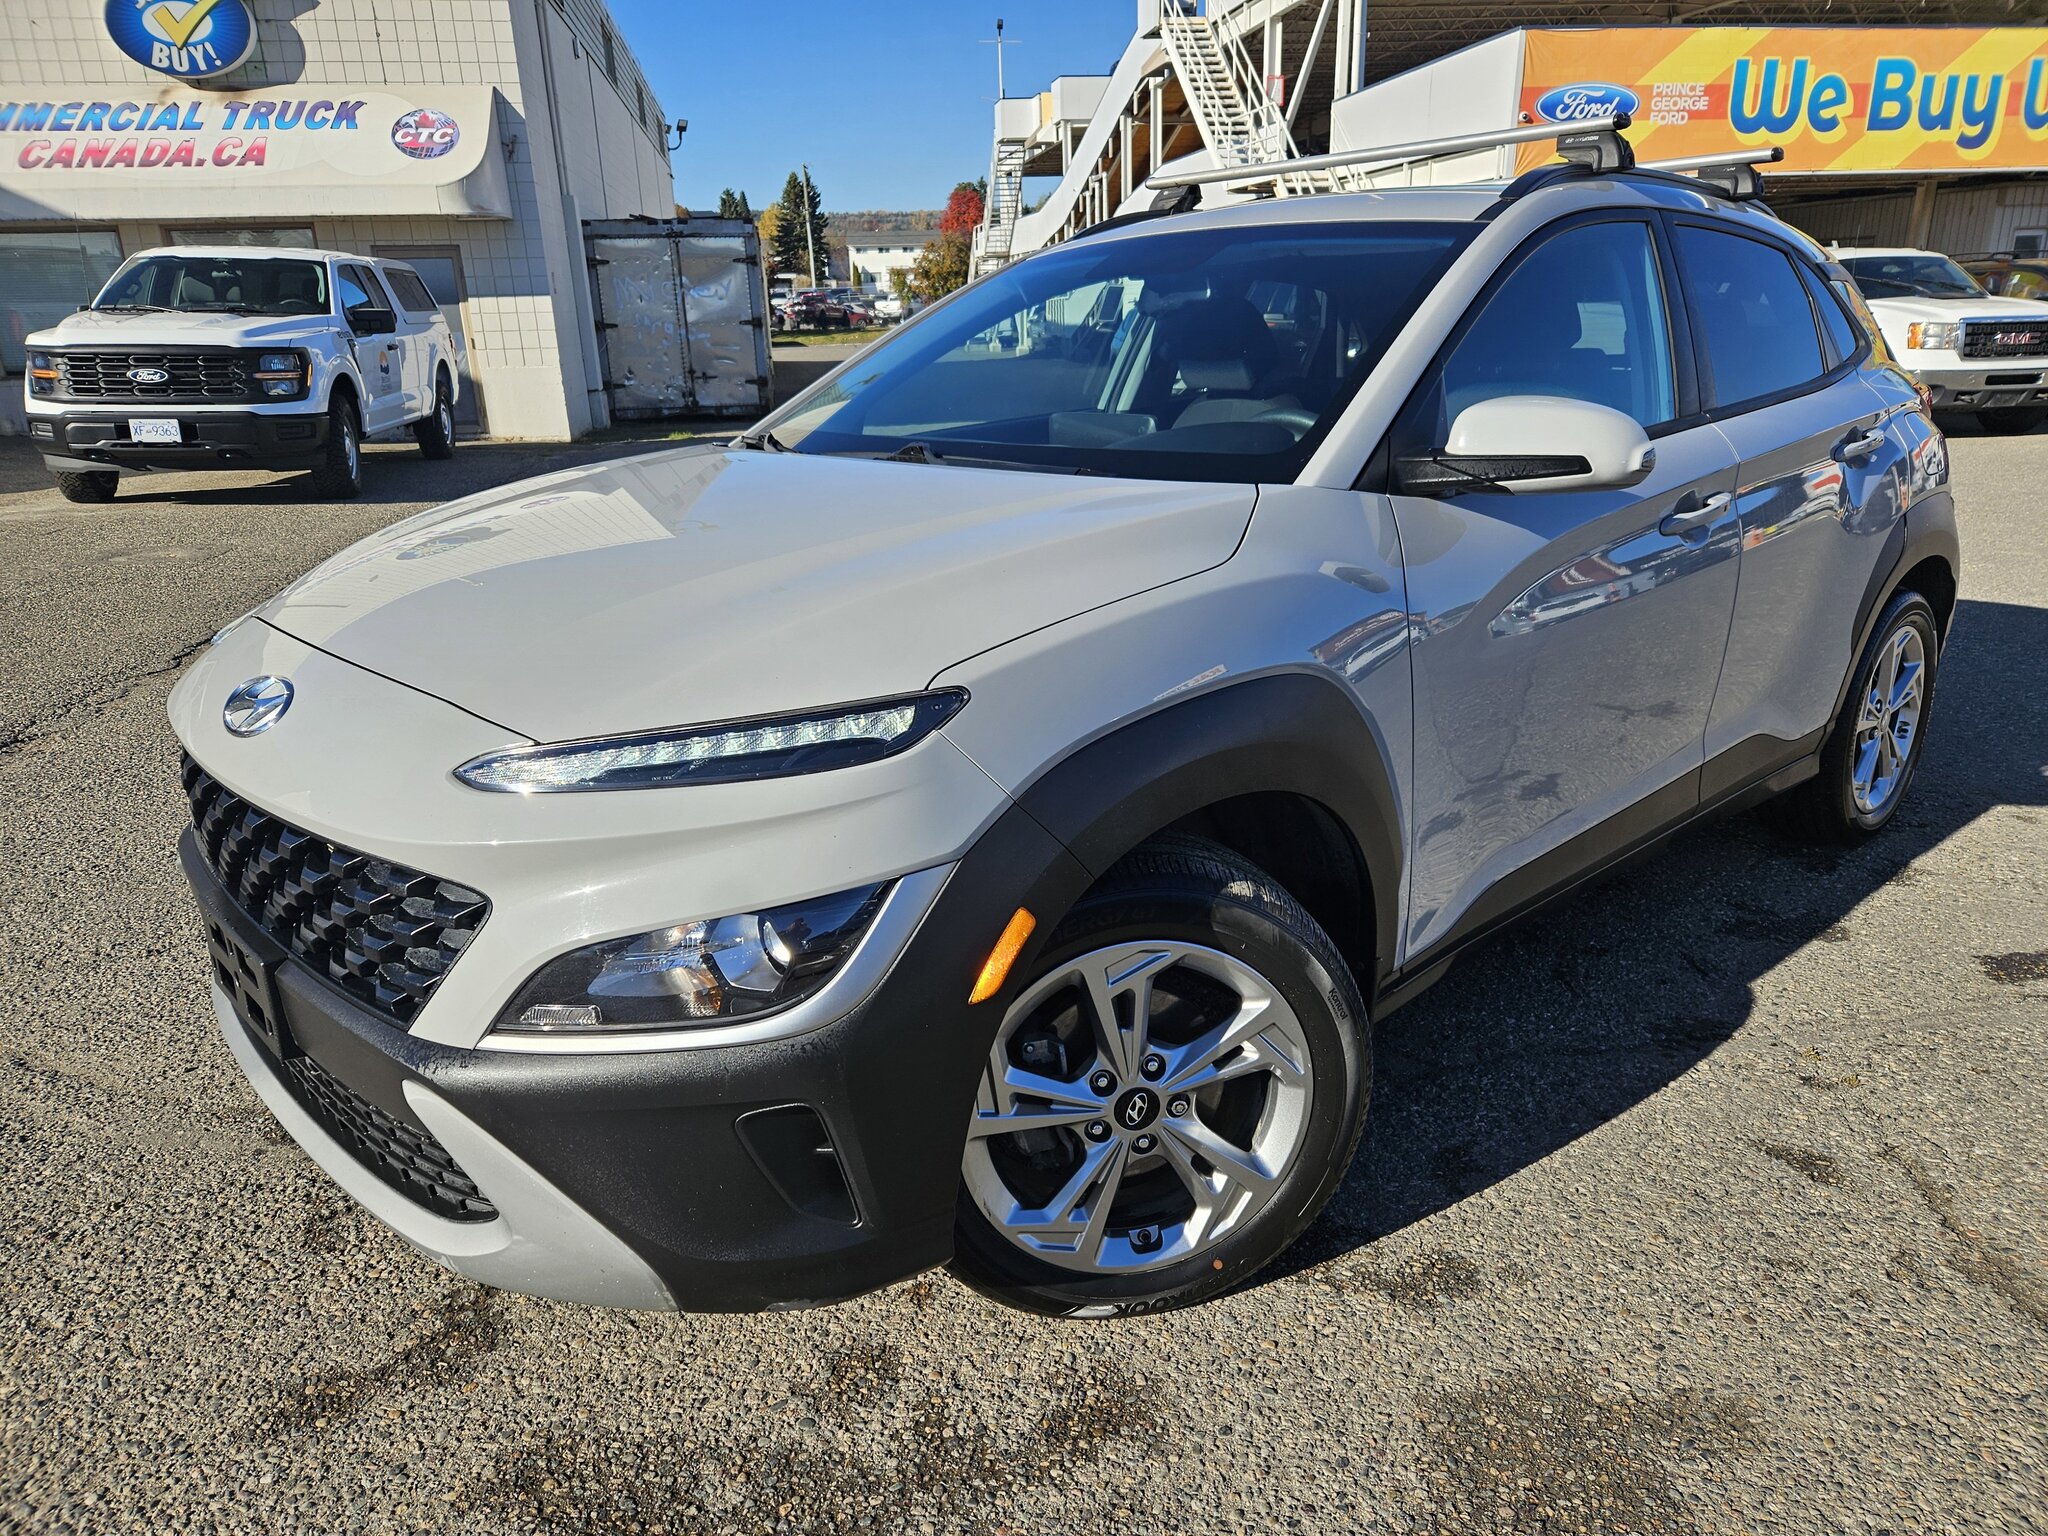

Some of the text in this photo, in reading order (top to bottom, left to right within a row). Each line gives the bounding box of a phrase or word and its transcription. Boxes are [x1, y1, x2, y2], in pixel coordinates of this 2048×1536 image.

[151, 41, 222, 72] BUY!
[1555, 88, 1621, 120] Ford
[1651, 97, 1710, 110] GEORGE
[1653, 83, 1705, 97] PRINCE
[1729, 58, 1848, 135] We
[1866, 58, 2004, 150] Buy
[221, 100, 368, 131] TRUCK
[1650, 112, 1688, 125] FORD
[394, 127, 454, 144] CTC
[17, 136, 268, 169] CANADA.CA
[1328, 987, 1348, 1020] Kontrol
